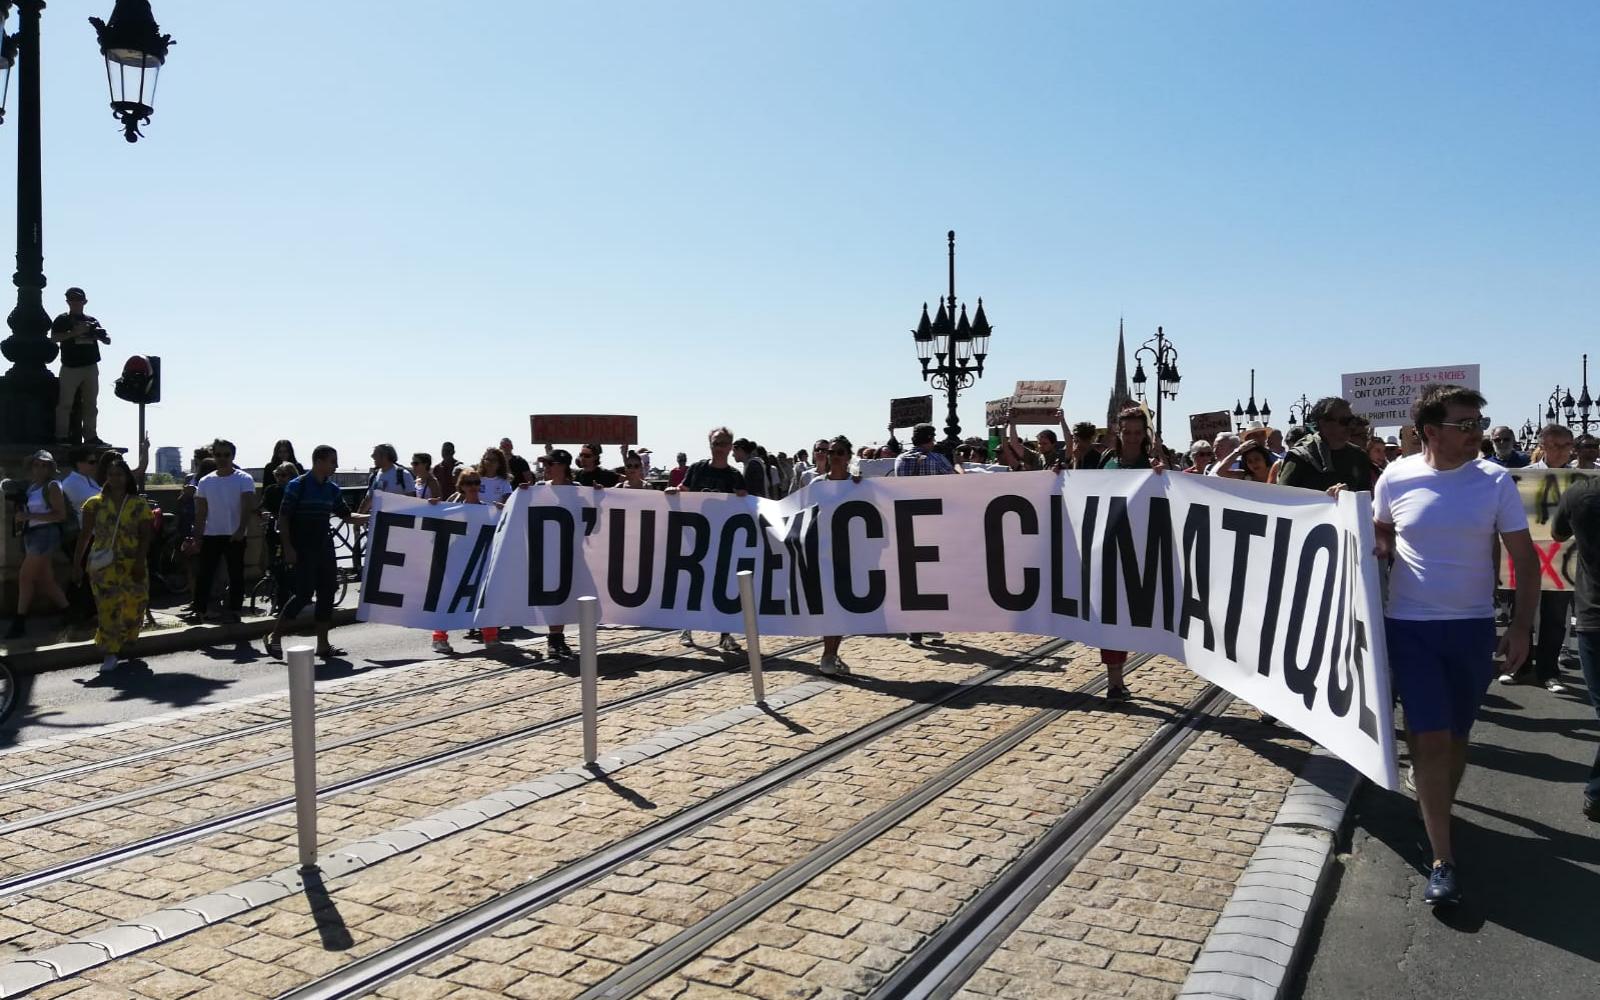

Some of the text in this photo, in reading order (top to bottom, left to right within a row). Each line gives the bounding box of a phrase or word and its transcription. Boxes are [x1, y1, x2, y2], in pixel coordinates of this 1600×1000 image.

[1414, 373, 1430, 382] LES
[1438, 371, 1466, 381] RICHES
[1355, 378, 1367, 387] EN
[1354, 390, 1371, 399] ONT
[364, 511, 508, 614] ETA
[528, 498, 949, 615] D'URGENCE
[984, 495, 1379, 744] CLIMATIQUE
